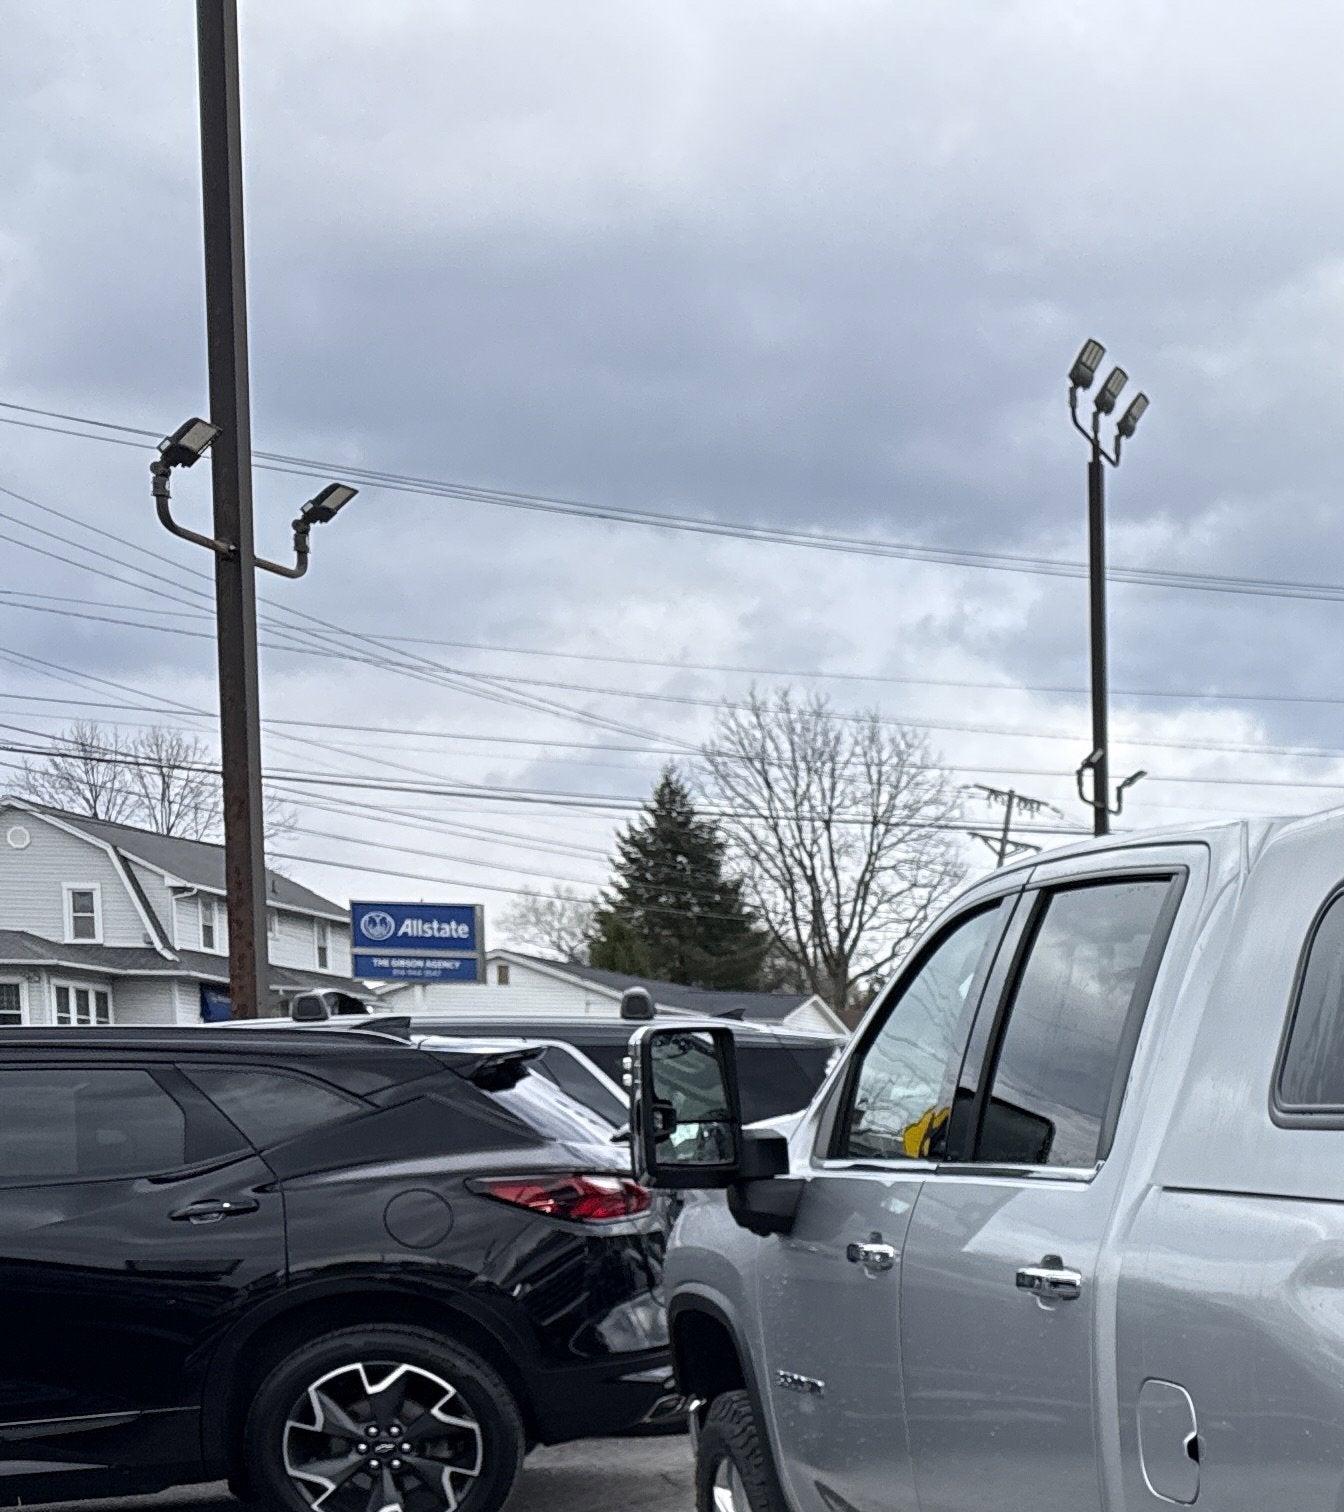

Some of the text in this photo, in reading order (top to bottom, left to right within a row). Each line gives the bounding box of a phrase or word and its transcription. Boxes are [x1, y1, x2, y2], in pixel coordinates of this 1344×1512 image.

[396, 918, 469, 939] Allstate
[372, 957, 390, 968] THE
[425, 959, 461, 970] AGENCY
